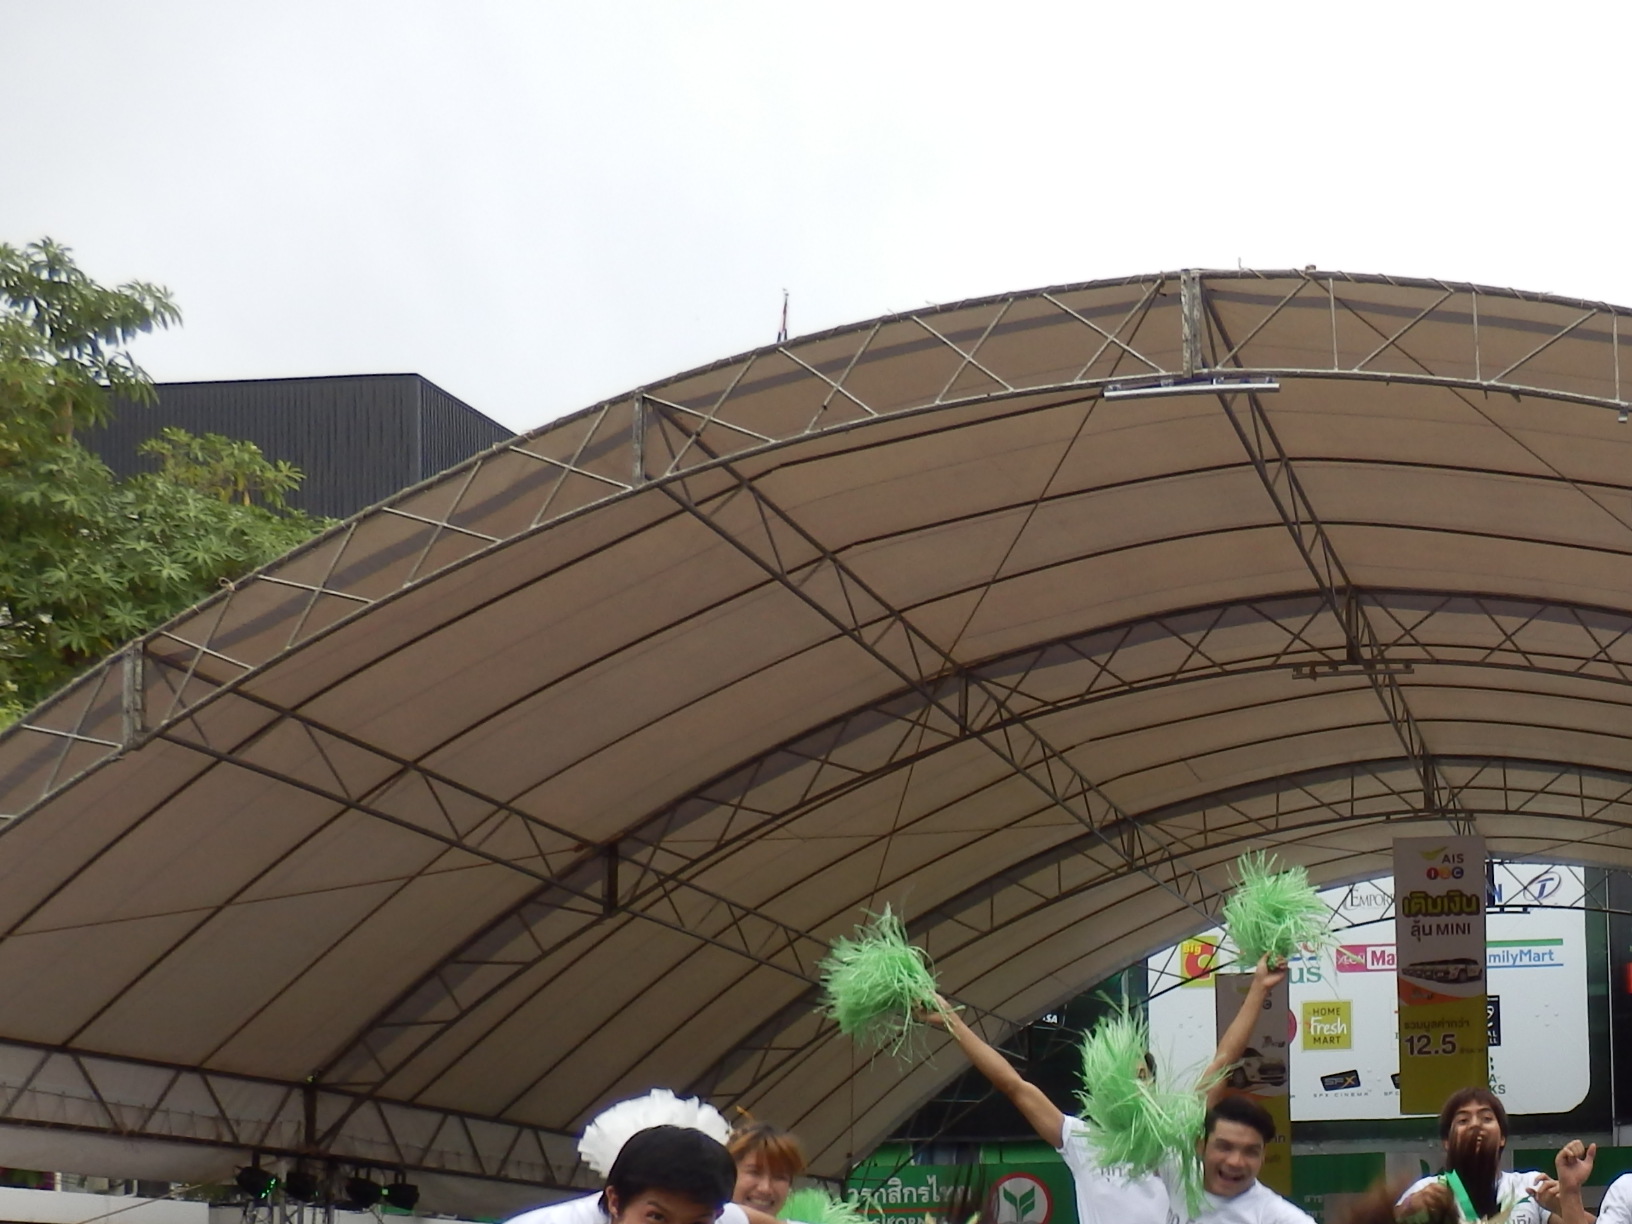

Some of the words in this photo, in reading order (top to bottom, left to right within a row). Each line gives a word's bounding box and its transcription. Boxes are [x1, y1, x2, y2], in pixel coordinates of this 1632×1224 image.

[1441, 853, 1465, 864] AIS
[1435, 922, 1471, 936] MINI
[1488, 949, 1554, 966] milyMart
[1312, 1007, 1341, 1016] HOME
[1310, 1016, 1347, 1035] Fresh
[1313, 1036, 1341, 1045] MART
[1405, 1034, 1457, 1056] 12.5
